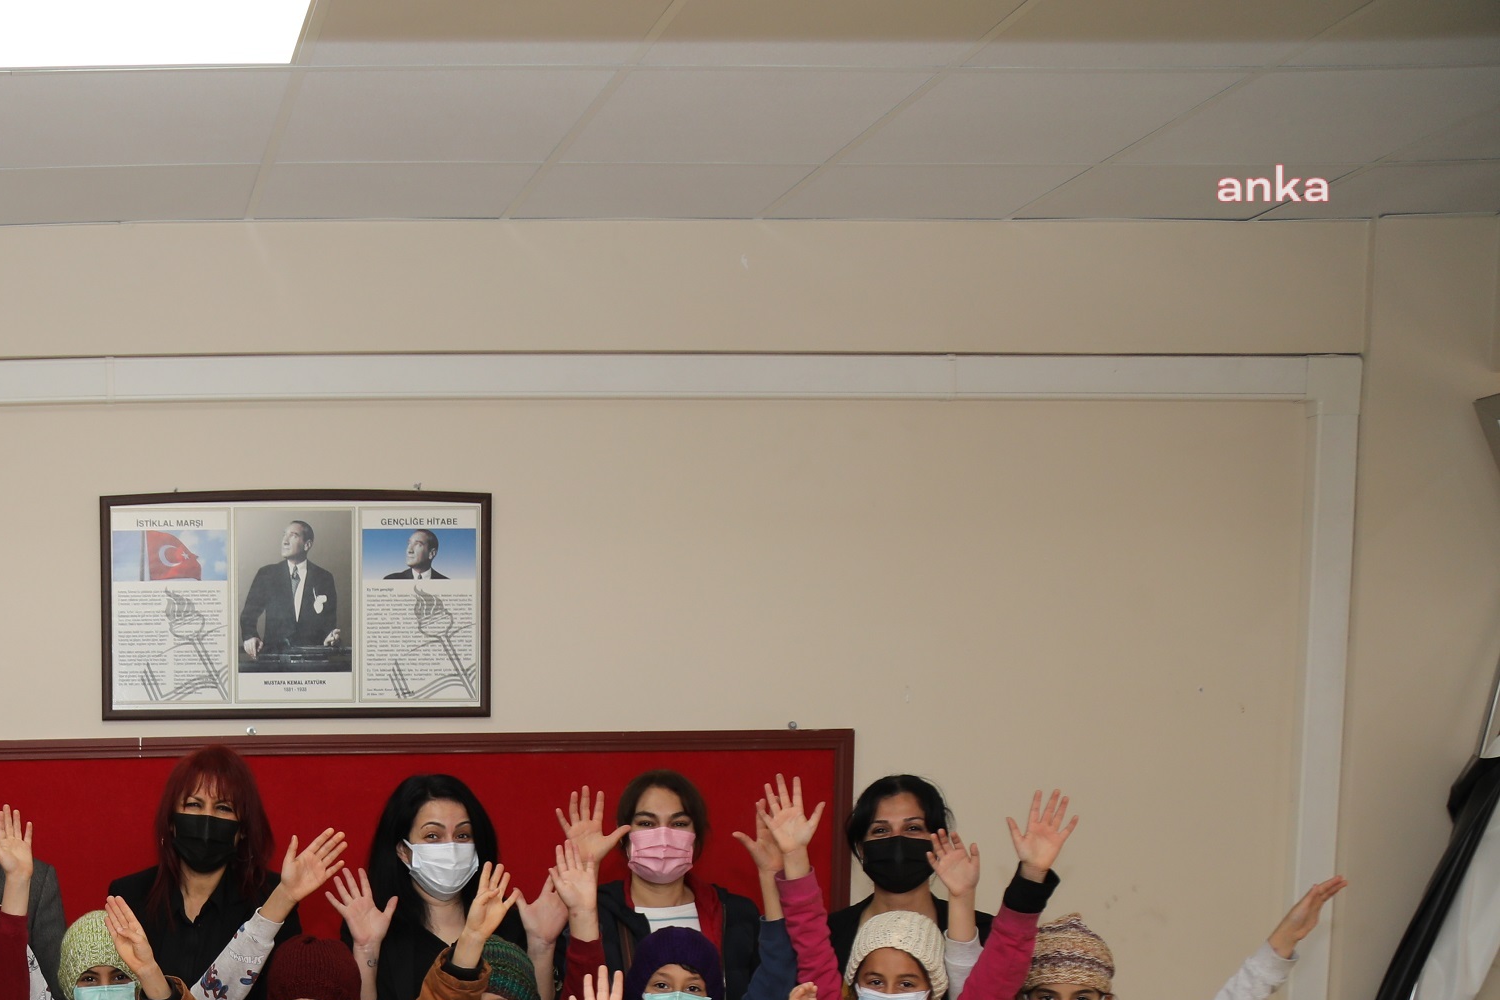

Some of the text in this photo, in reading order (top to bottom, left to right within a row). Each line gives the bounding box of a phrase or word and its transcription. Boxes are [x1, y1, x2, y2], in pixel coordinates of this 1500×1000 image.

[136, 518, 204, 528] İSTİKLAL MARŞI
[380, 517, 458, 527] GENÇLİĞE HİTABE
